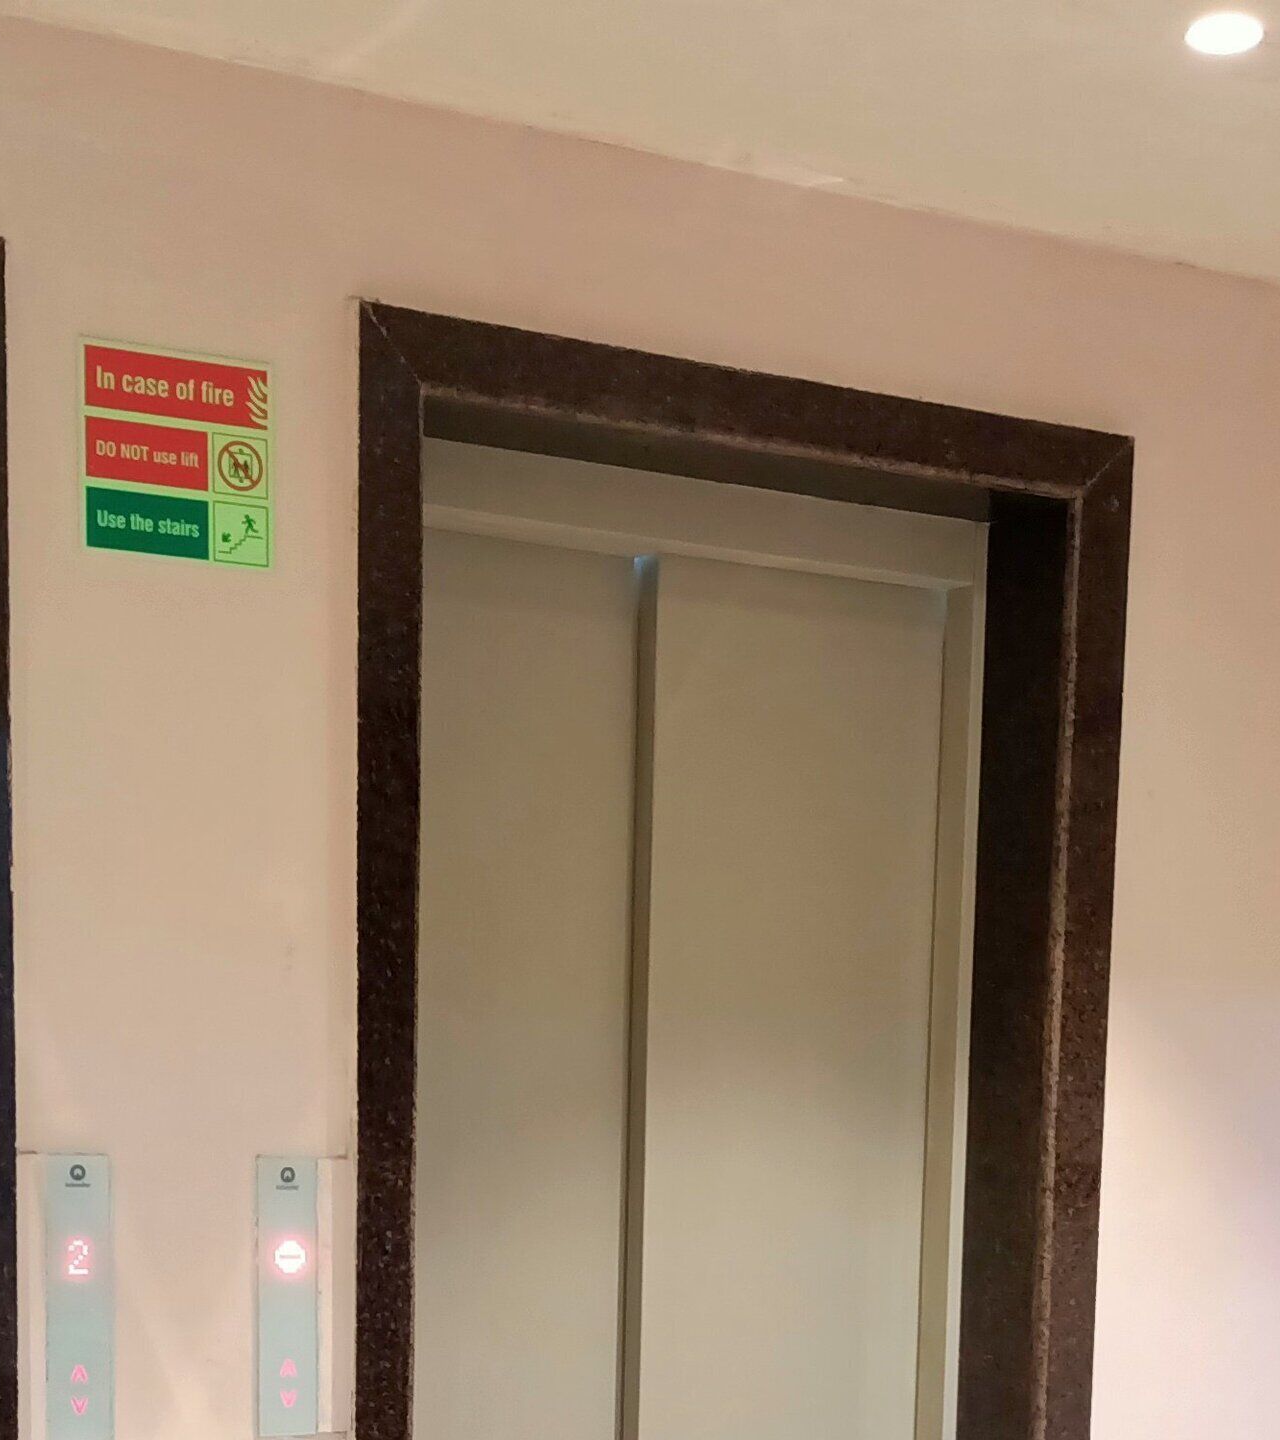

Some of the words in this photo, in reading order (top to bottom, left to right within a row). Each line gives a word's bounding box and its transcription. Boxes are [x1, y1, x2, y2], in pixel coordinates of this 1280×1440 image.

[96, 365, 115, 391] In
[122, 373, 169, 398] case
[176, 379, 195, 401] of
[201, 380, 234, 407] fire
[96, 439, 116, 457] DO
[121, 442, 149, 461] NOT
[153, 449, 177, 463] use
[181, 451, 199, 468] lift
[97, 509, 126, 530] Use
[130, 513, 154, 532] the
[158, 517, 200, 538] stairs
[68, 1239, 89, 1275] 2
